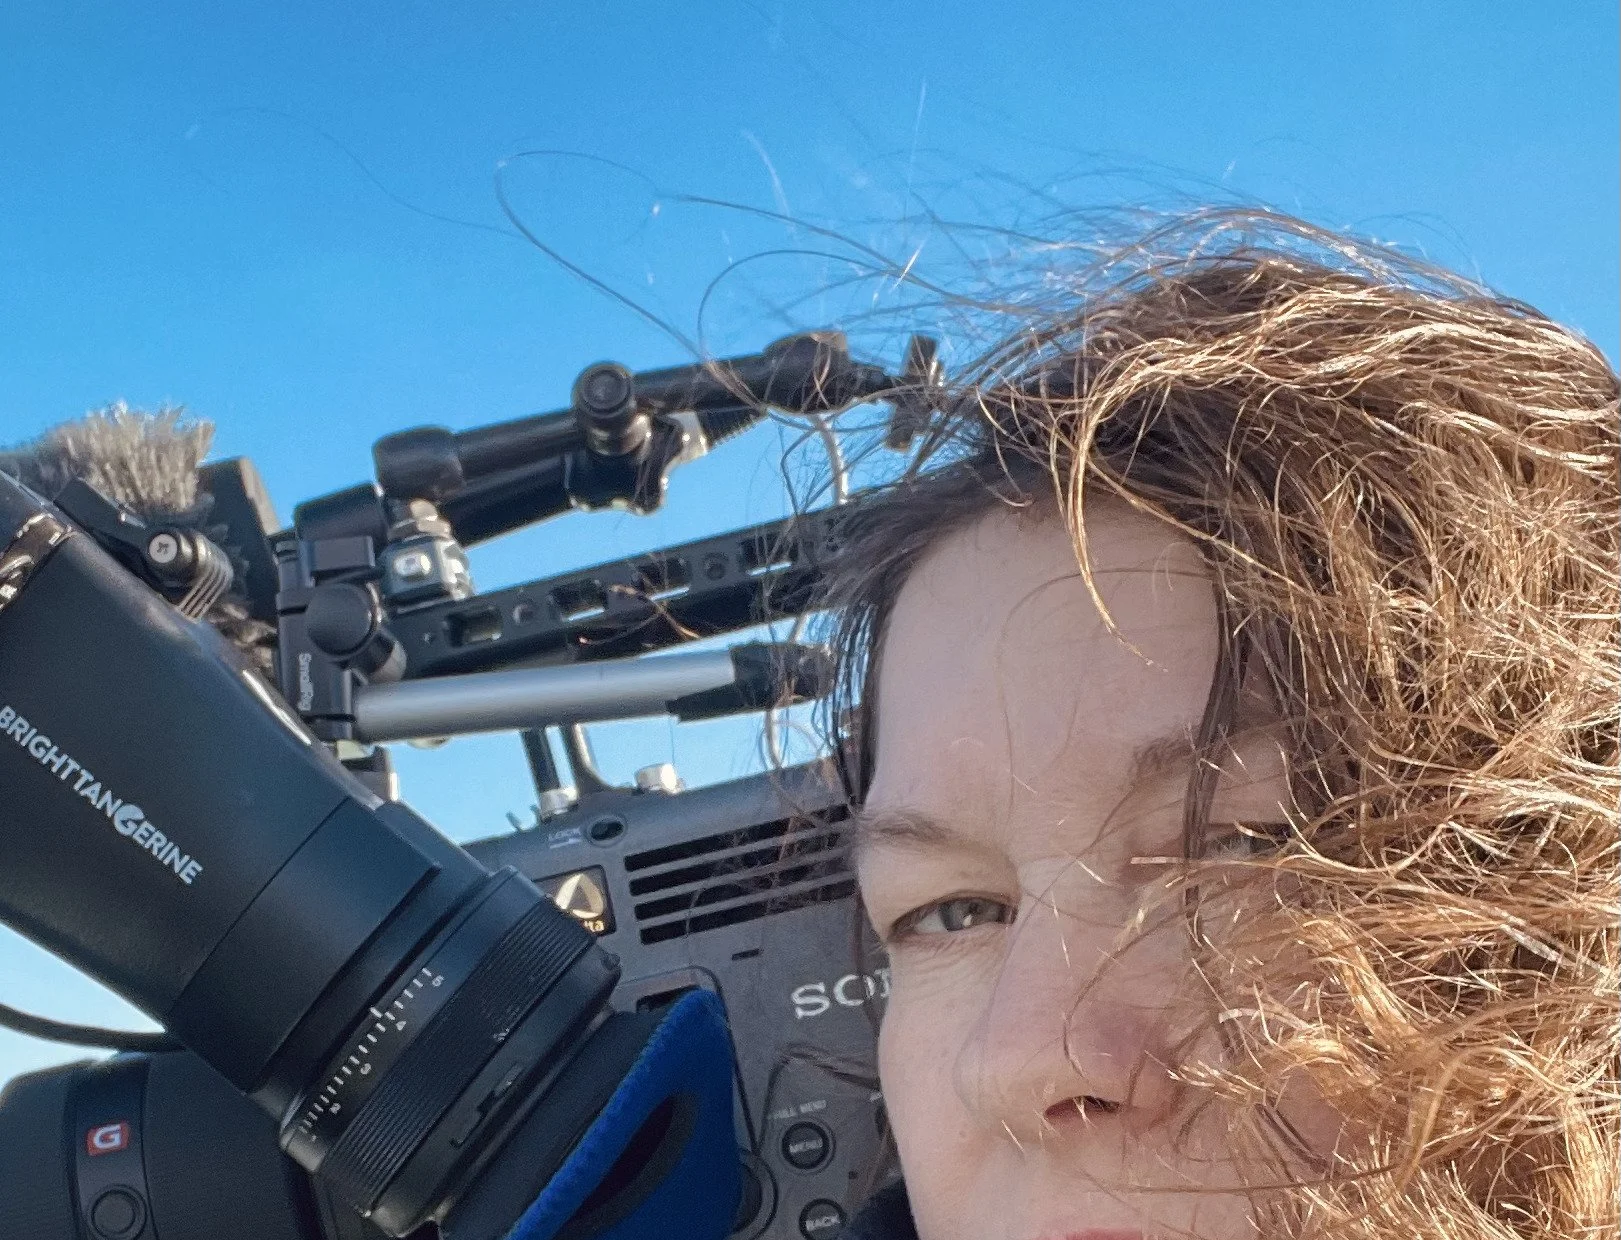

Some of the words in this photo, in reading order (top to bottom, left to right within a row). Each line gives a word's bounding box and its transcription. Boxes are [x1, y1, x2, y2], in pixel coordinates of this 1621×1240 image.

[0, 705, 203, 884] BRIGHTTANGERINE
[432, 974, 445, 987] 5
[360, 1062, 372, 1075] 3
[93, 1123, 121, 1150] G
